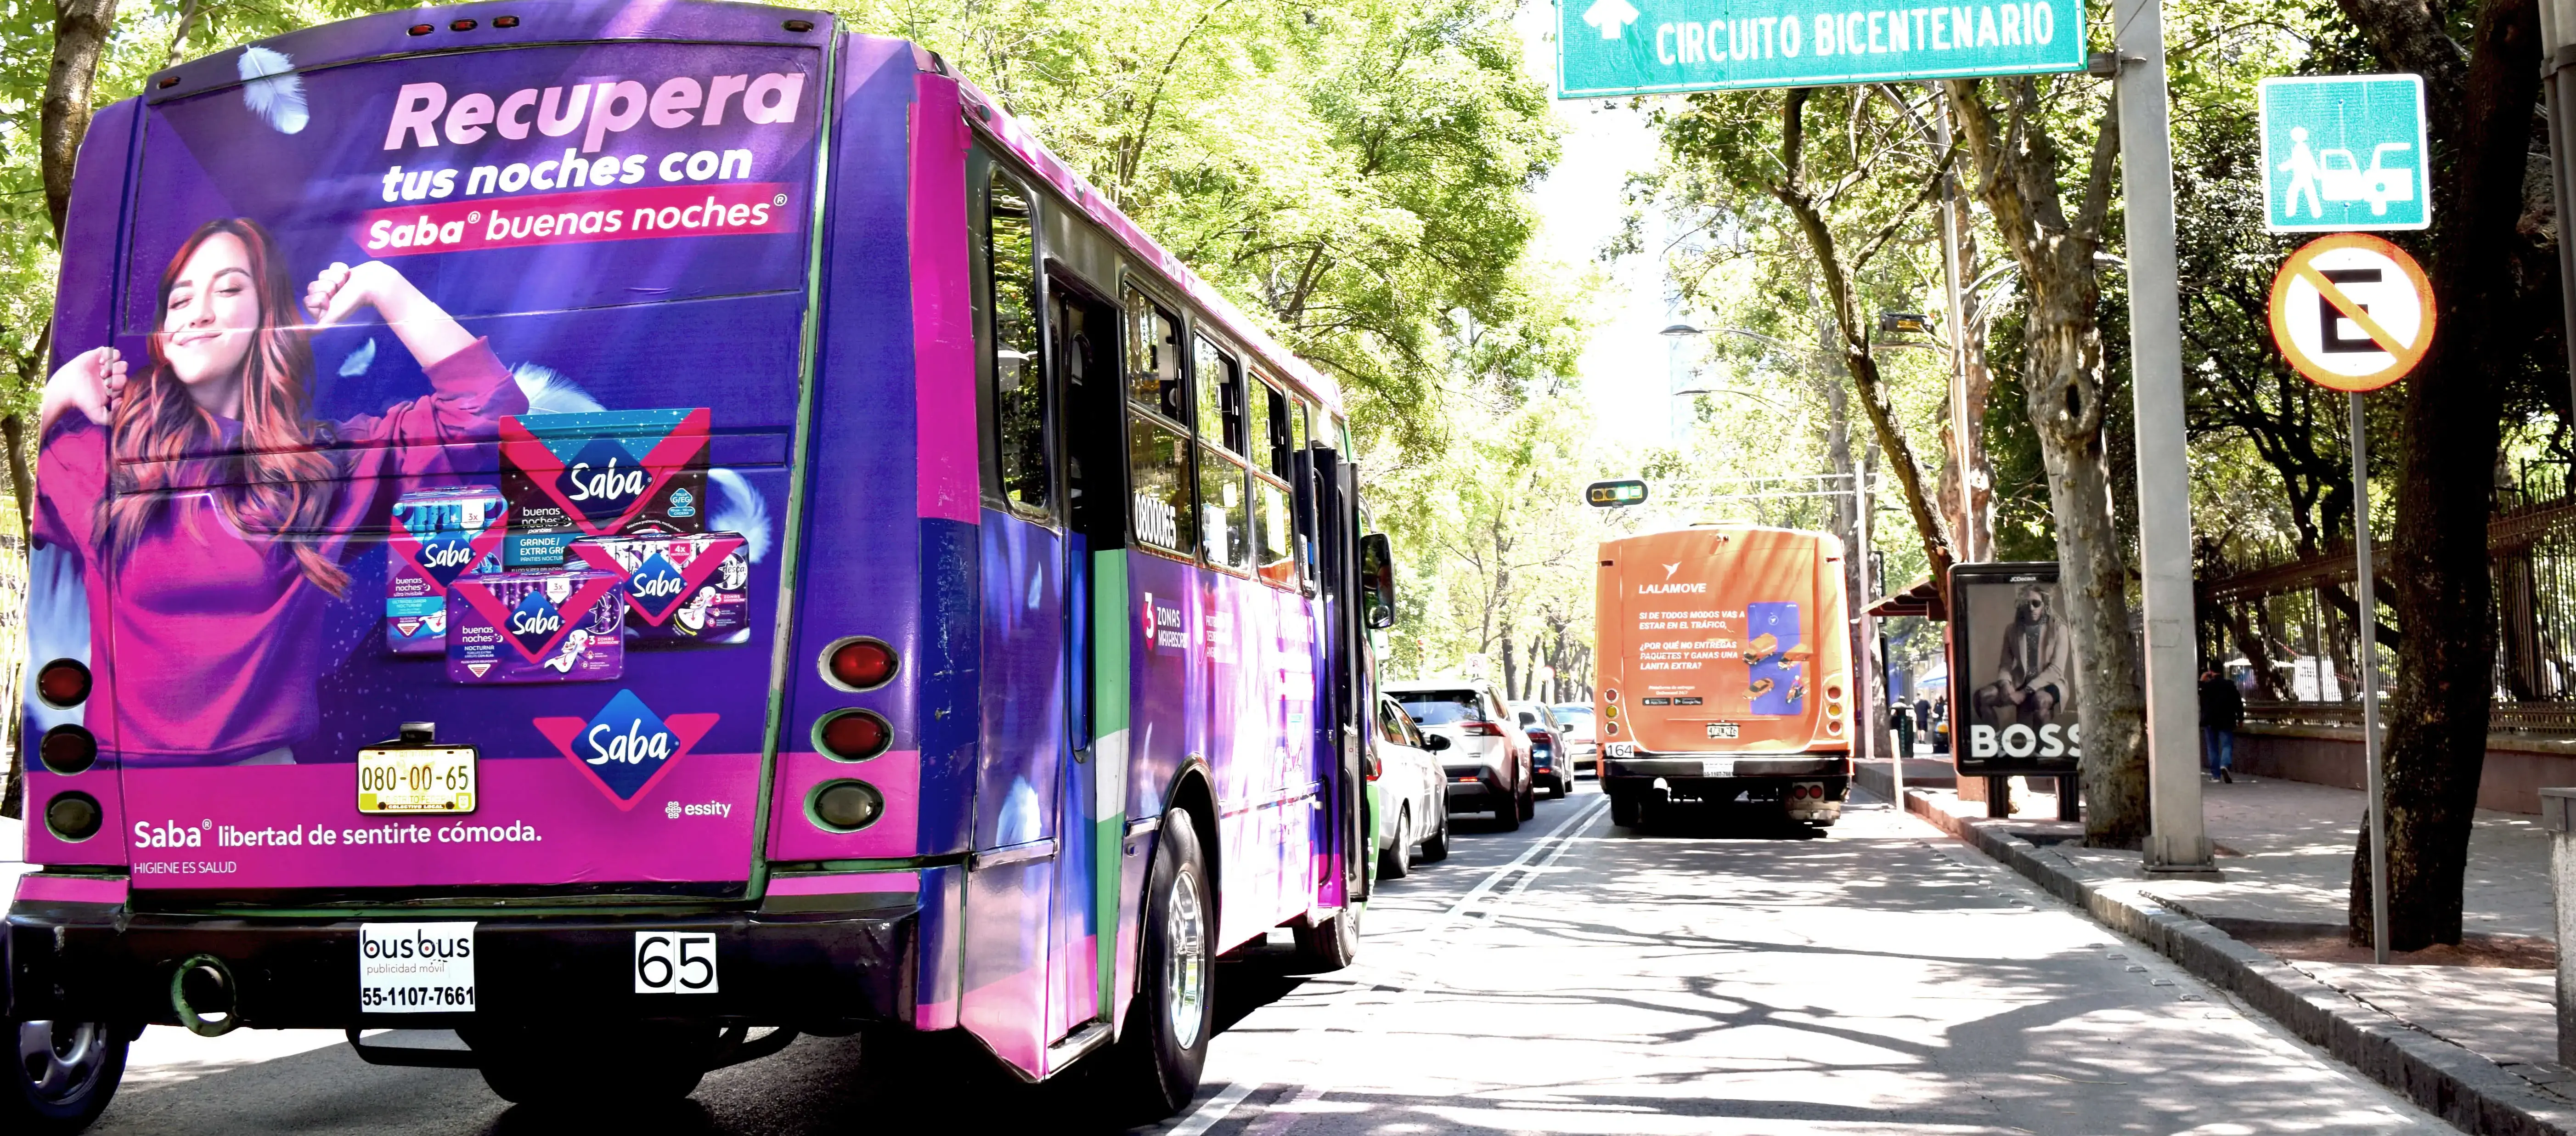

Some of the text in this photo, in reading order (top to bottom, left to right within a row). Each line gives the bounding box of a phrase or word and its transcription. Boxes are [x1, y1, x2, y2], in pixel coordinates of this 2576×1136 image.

[1657, 1, 2054, 65] CIRCUITO BICENTENARIO
[384, 72, 804, 153] Recupera
[381, 148, 753, 202] tus noches con
[485, 209, 622, 241] buenas
[2318, 268, 2389, 353] E
[523, 507, 560, 516] buenas
[1135, 493, 1177, 549] 0800065
[520, 537, 560, 546] GRANDE/
[424, 540, 471, 568] Saba
[632, 570, 682, 597] Saba
[1639, 583, 1707, 594] LALAMOVE
[715, 593, 722, 603] 3
[512, 608, 560, 635] Saba
[1145, 592, 1154, 639] 3
[1157, 606, 1180, 628] ZONAS
[1691, 619, 1727, 629] TRÁFICO,
[462, 625, 494, 634] buenas
[462, 634, 493, 643] noches
[589, 635, 596, 645] 3
[1639, 642, 1661, 651] ¿POR
[1663, 640, 1679, 650] QUÉ
[586, 718, 671, 765] Saba
[1607, 744, 1632, 756] 164
[362, 764, 469, 791] 080-00-65
[685, 800, 732, 818] essity
[218, 823, 302, 847] libertad
[309, 824, 337, 846] de
[343, 822, 431, 845] sentirte
[437, 820, 542, 843] cómoda.
[134, 861, 237, 874] HIGIENE ES SALUD
[367, 962, 445, 976] publicidad móvil
[638, 936, 714, 989] 65
[362, 986, 474, 1006] 55-1107-7661
